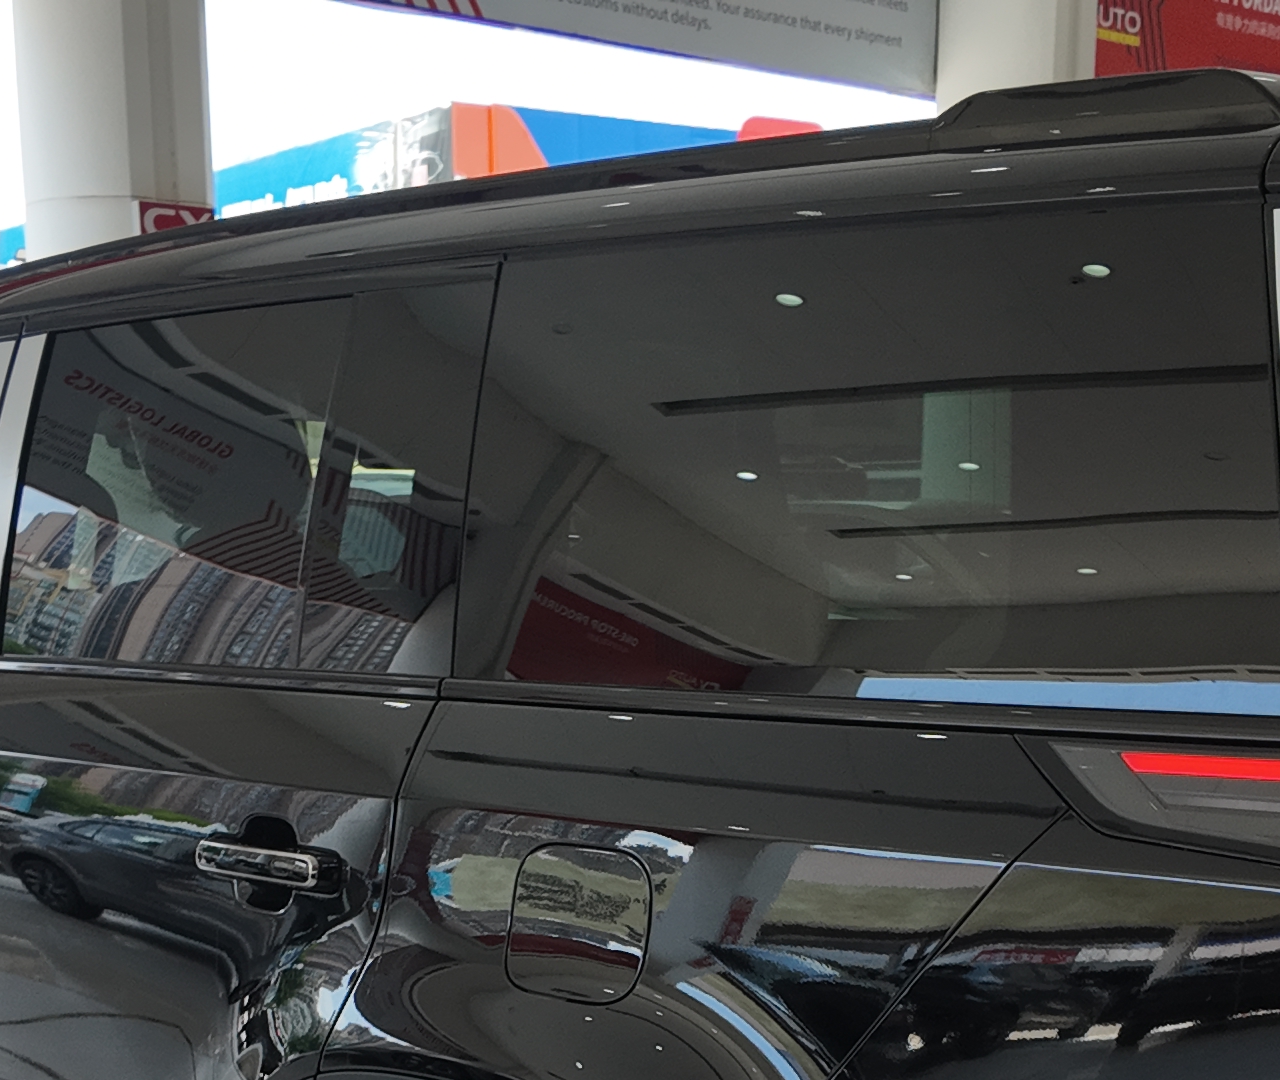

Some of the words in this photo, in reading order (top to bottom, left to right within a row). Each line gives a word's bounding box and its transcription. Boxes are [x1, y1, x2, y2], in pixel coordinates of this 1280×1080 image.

[622, 3, 669, 23] without
[671, 9, 713, 32] delays.
[743, 7, 798, 28] assurance
[800, 15, 822, 33] that
[824, 23, 853, 42] every
[855, 28, 903, 48] shipment
